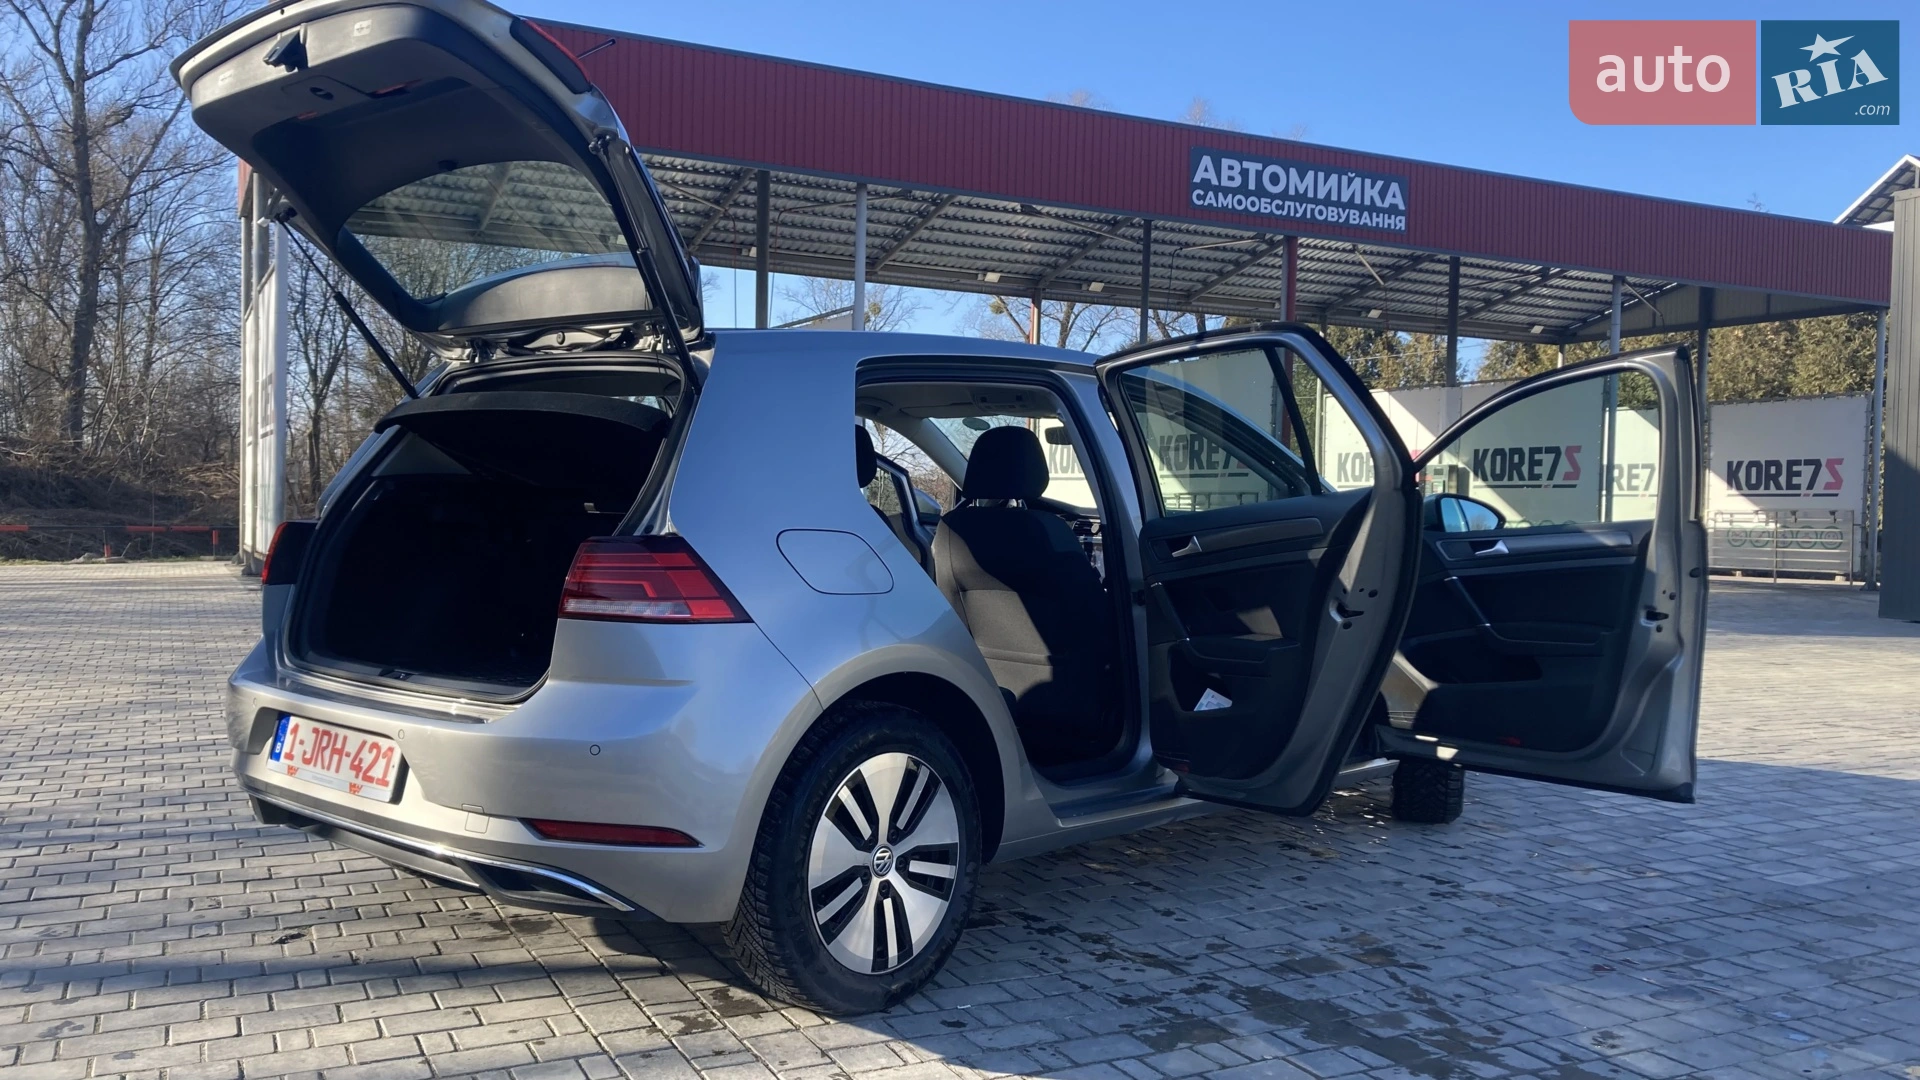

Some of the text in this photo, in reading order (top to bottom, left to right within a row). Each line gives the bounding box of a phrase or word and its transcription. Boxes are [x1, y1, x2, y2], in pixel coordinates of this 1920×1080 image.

[1192, 154, 1406, 211] АВТОМИЙКА
[1191, 188, 1406, 231] САМООБСЛУГОВУВАННЯ
[1472, 445, 1582, 482] KORE7S
[1726, 457, 1844, 491] KORE7S
[284, 722, 395, 788] 1-JRH-421
